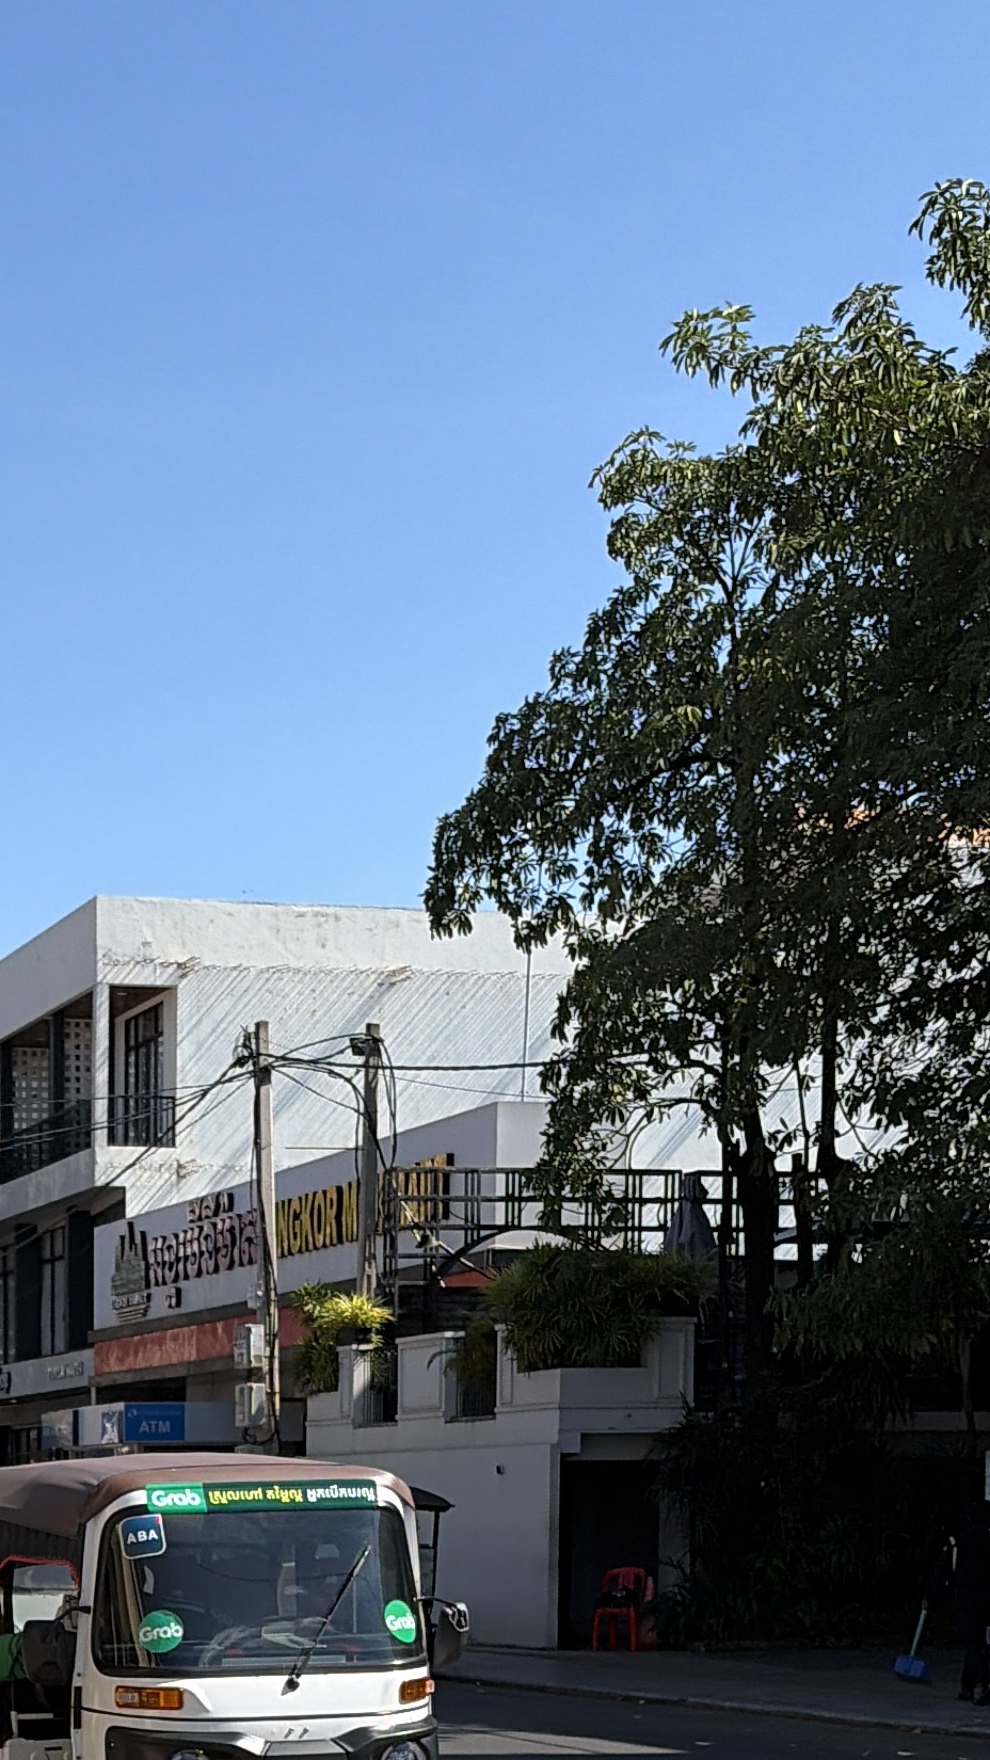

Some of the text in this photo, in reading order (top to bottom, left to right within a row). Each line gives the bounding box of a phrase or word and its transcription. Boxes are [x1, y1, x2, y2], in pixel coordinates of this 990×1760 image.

[276, 1186, 339, 1258] NGKOR
[139, 1420, 171, 1434] ATM
[151, 1489, 202, 1507] Grab
[127, 1528, 159, 1545] ABA
[385, 1611, 416, 1631] Grab
[139, 1621, 185, 1643] Grab
